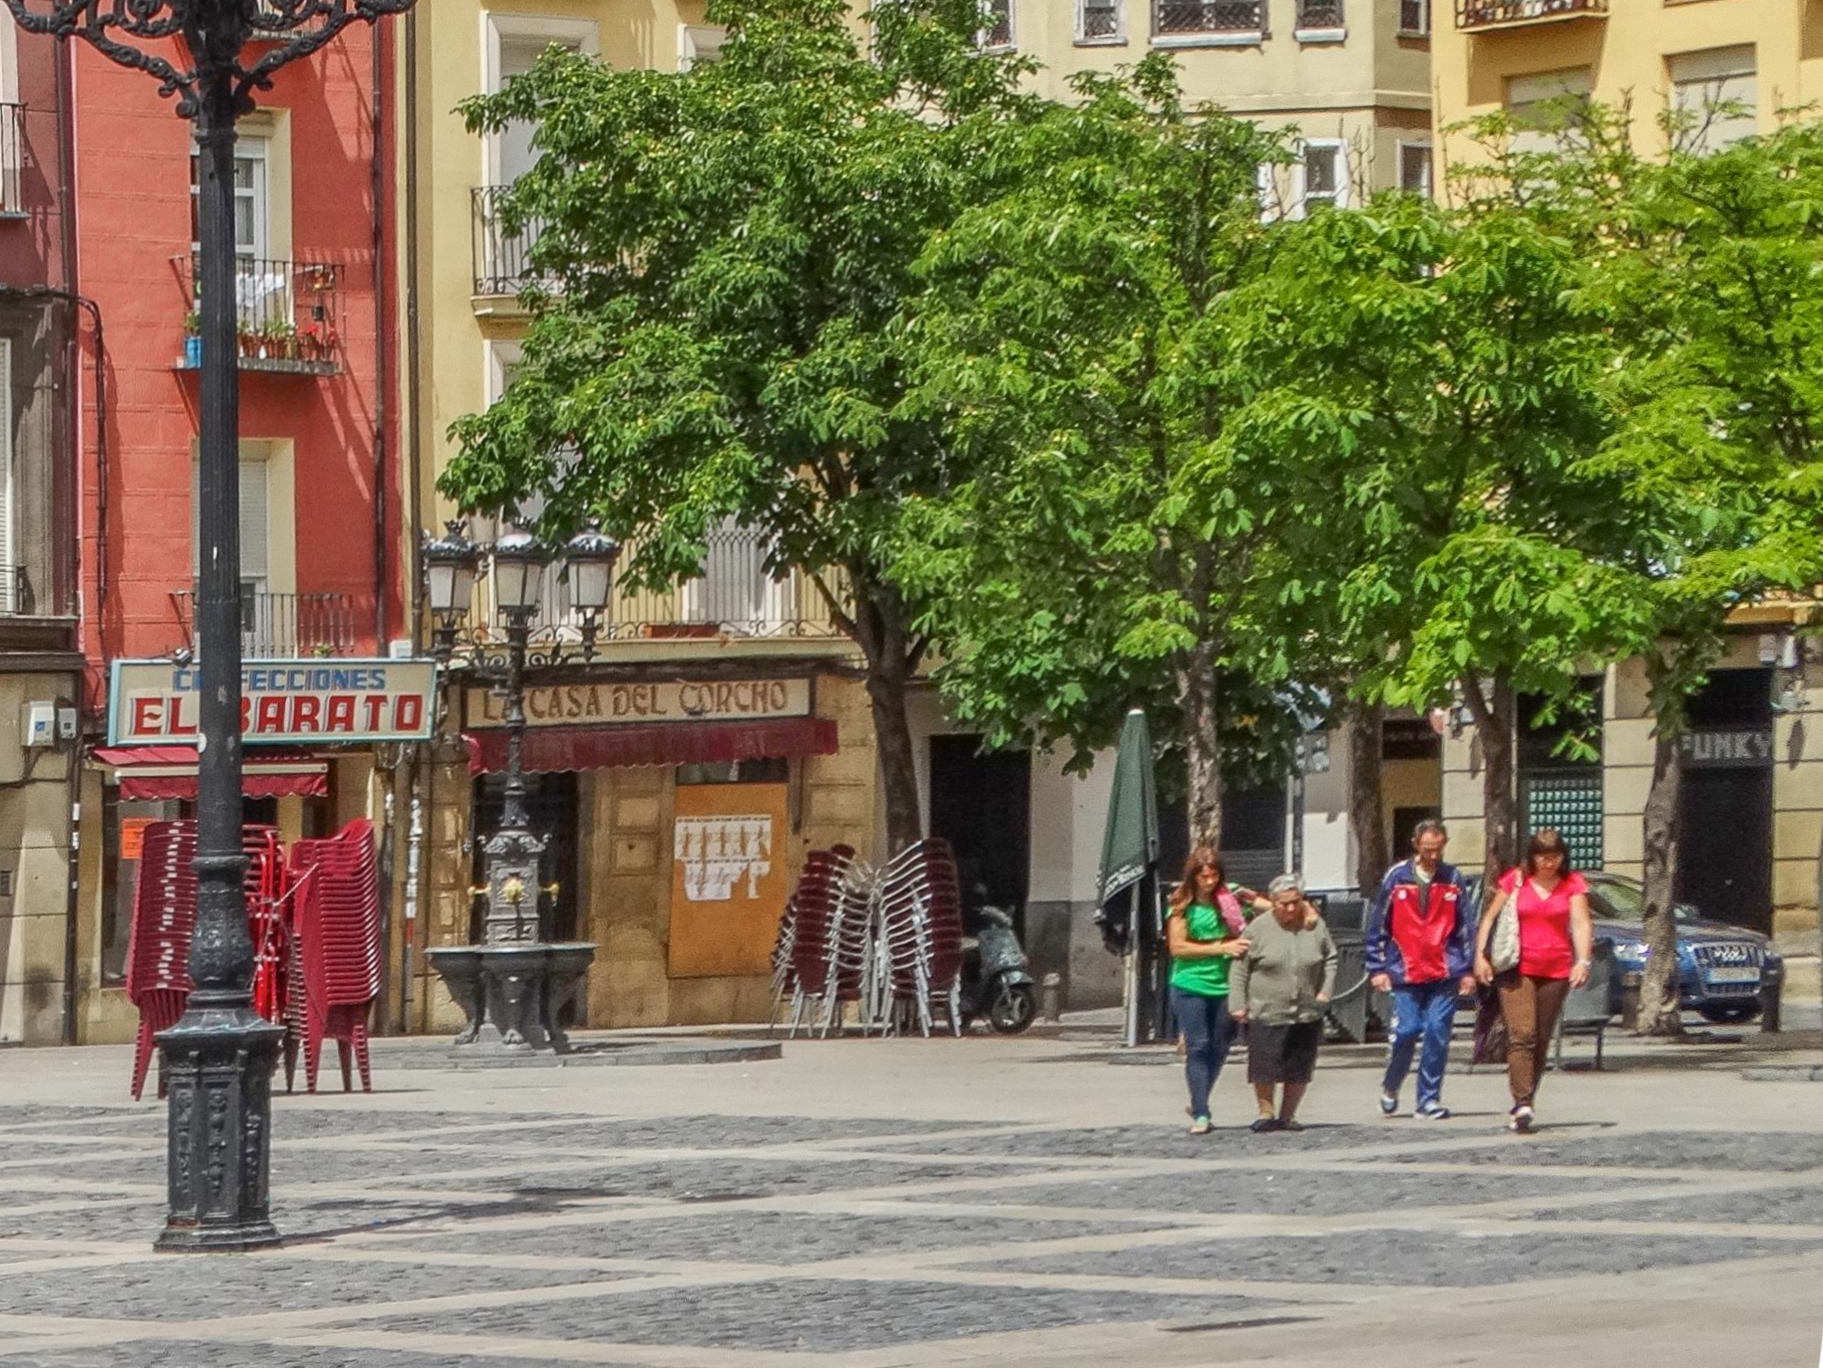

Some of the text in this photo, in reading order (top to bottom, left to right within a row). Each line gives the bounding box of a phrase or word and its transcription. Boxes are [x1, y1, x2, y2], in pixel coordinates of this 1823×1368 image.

[130, 696, 199, 735] EL
[528, 685, 602, 718] CASA
[612, 684, 668, 717] DEL
[678, 681, 789, 713] CORCHO
